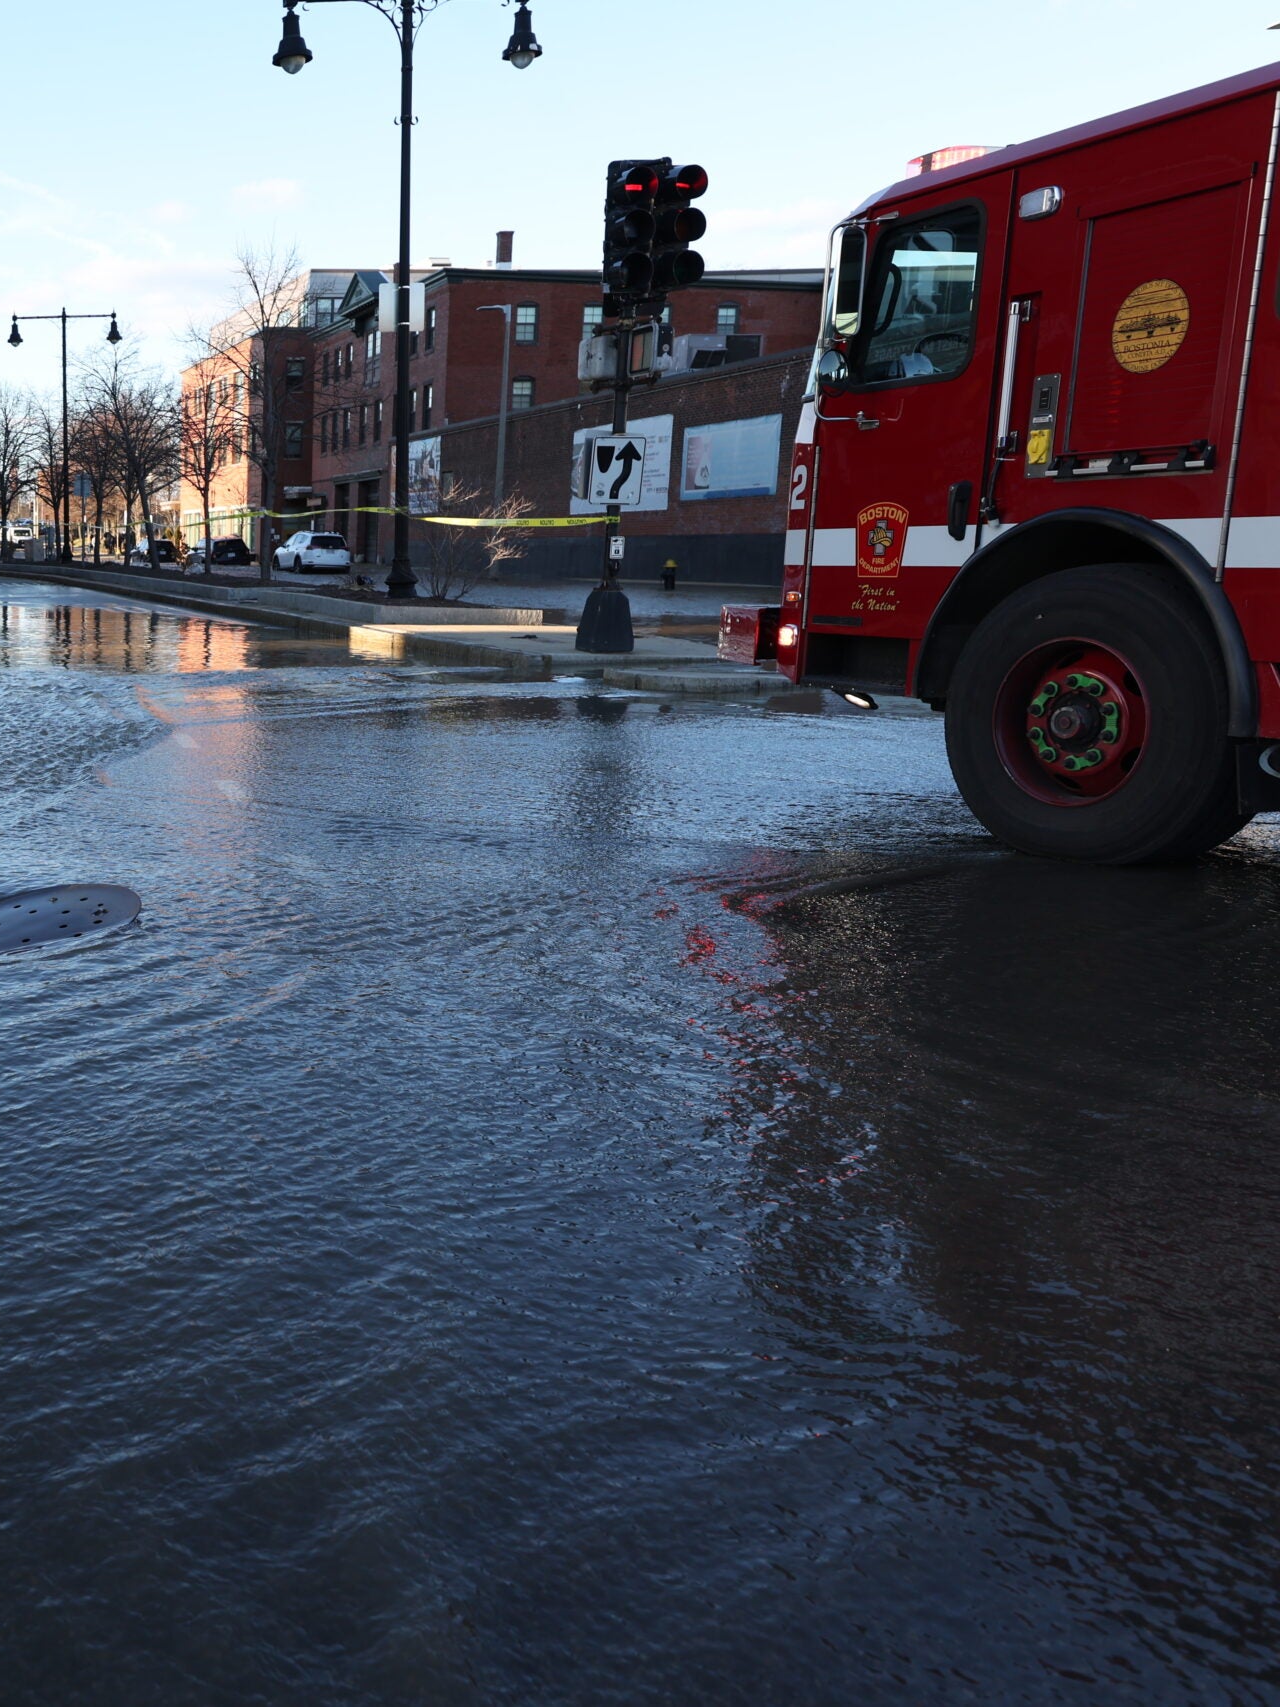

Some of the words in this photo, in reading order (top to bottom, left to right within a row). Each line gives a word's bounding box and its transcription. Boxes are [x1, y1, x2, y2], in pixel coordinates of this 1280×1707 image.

[1124, 340, 1170, 352] BOSTONIA
[790, 464, 808, 510] 2
[859, 506, 907, 526] BOSTON
[859, 556, 900, 574] DEPARTMENT
[872, 557, 885, 565] FIRE
[886, 584, 895, 596] in
[851, 599, 864, 610] the
